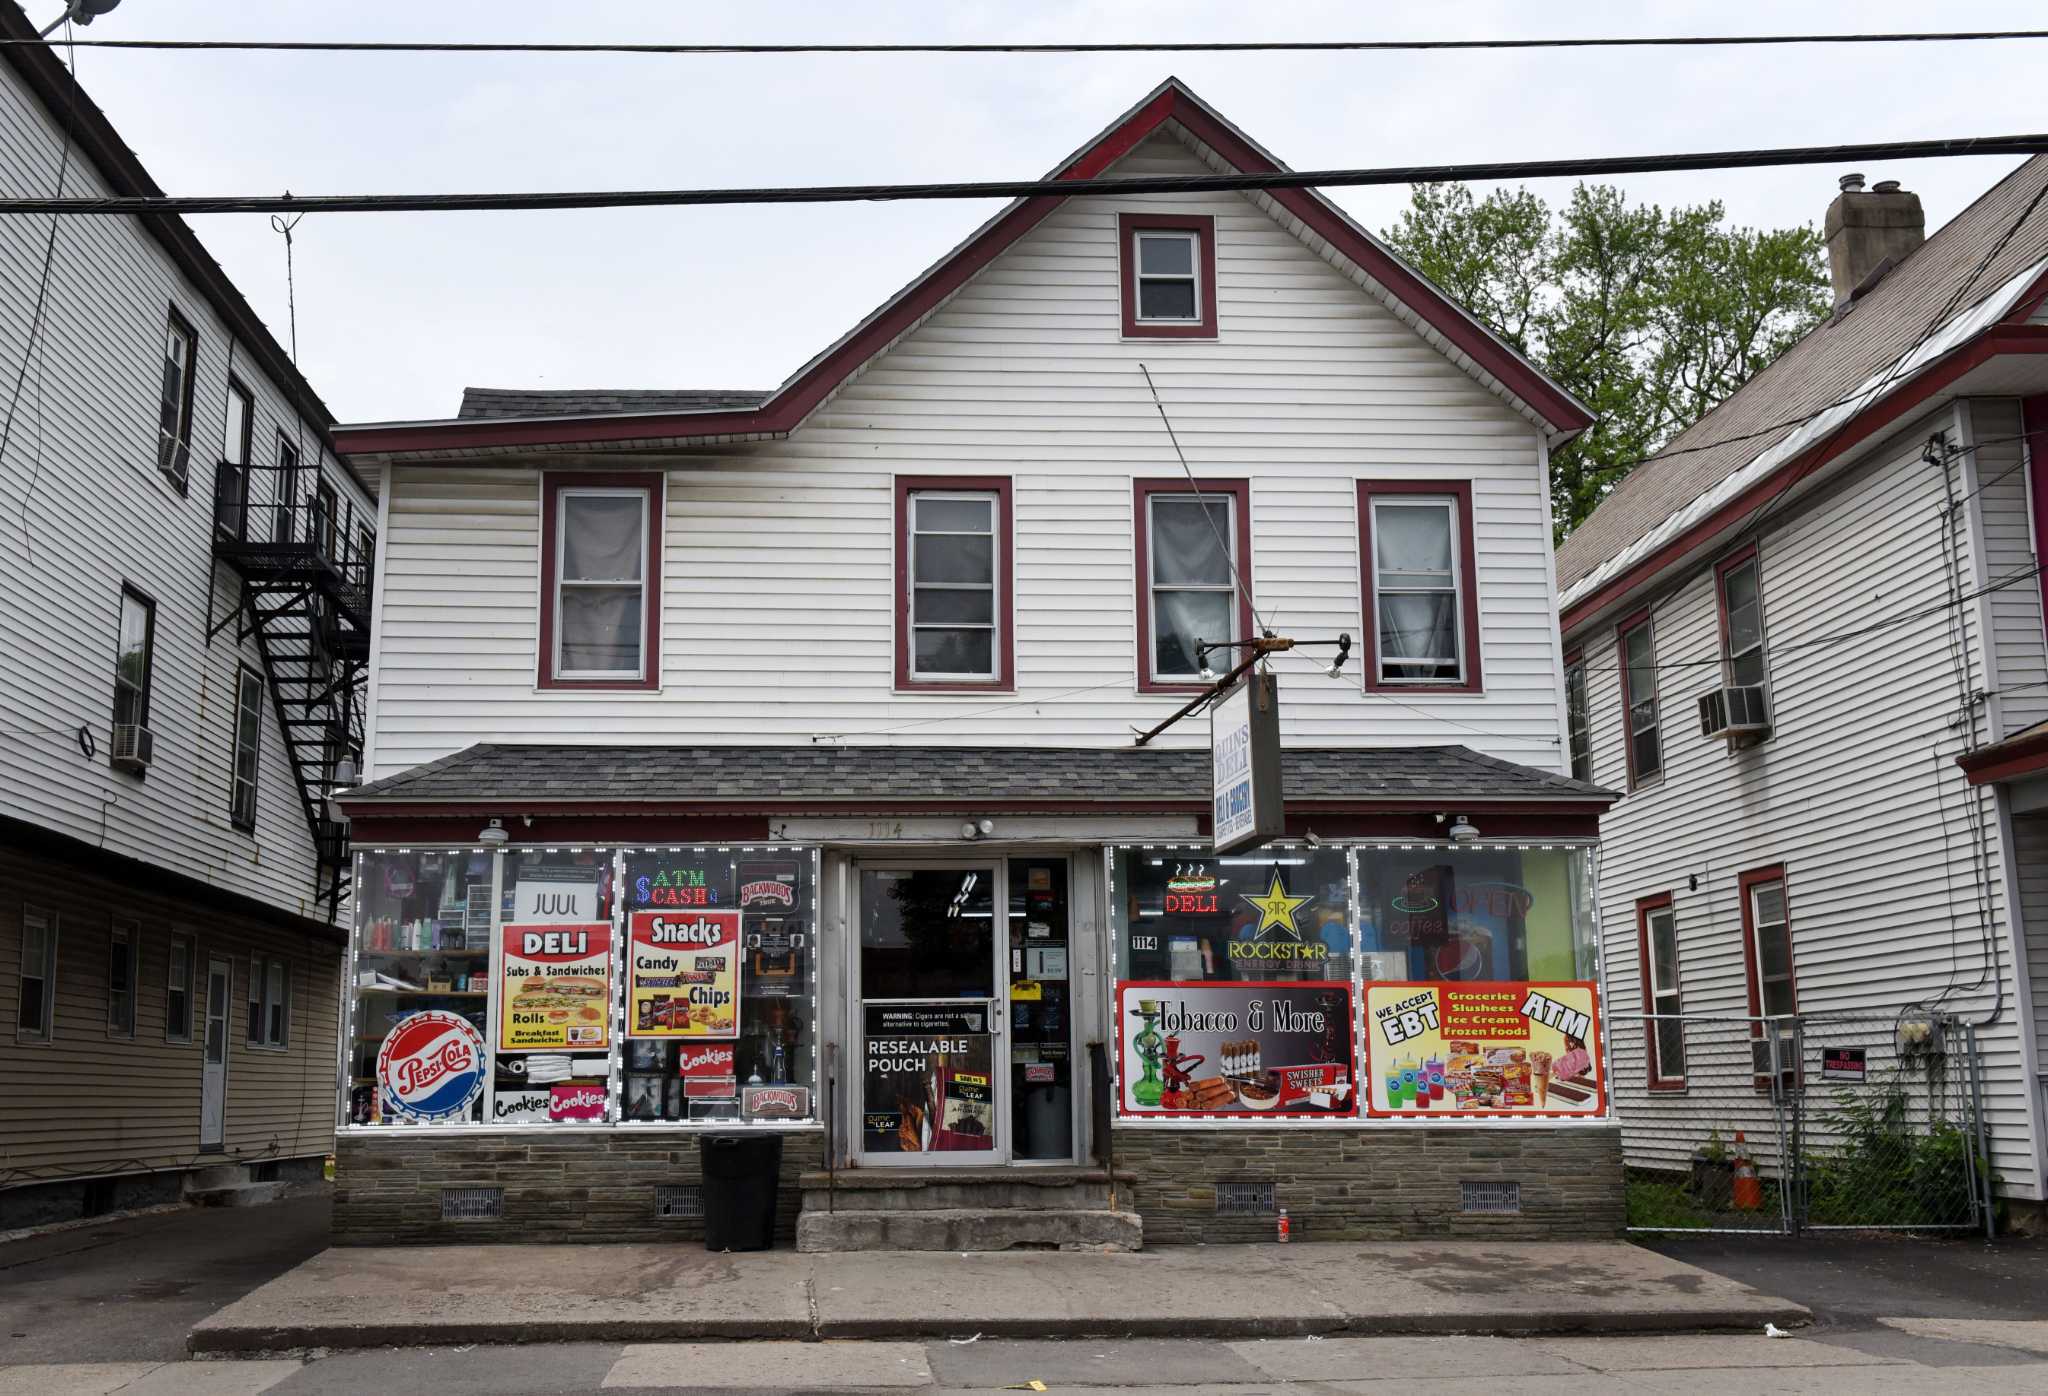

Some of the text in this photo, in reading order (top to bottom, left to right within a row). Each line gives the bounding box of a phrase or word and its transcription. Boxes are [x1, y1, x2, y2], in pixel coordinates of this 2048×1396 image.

[652, 870, 706, 886] ATM
[652, 887, 708, 904] CASH
[740, 881, 794, 906] BACKWOODS
[533, 893, 578, 915] JUUL
[1166, 895, 1217, 912] DELI
[652, 916, 722, 947] Snacks
[523, 930, 588, 955] DELI
[1133, 936, 1157, 950] 1114
[507, 964, 605, 977] Subs & Sandwiches
[637, 956, 678, 971] Candy
[689, 987, 730, 1008] Chips
[1376, 991, 1434, 1019] WE ACCEPT
[1448, 992, 1517, 1001] Groceries
[1156, 1000, 1325, 1032] Tobacco & More
[1452, 1003, 1514, 1012] Slushees
[1520, 991, 1590, 1041] ATM
[512, 1013, 544, 1024] Rolls
[882, 1012, 914, 1020] WARNING:
[915, 1013, 933, 1021] Cigars
[1381, 1002, 1440, 1046] EBT
[1447, 1015, 1520, 1024] Ice Cream
[1444, 1027, 1528, 1036] Frozen Foods
[868, 1040, 968, 1054] RESEALABLE
[679, 1048, 733, 1070] Cookies
[868, 1058, 926, 1072] POUCH
[1286, 1069, 1324, 1081] SWISHER
[1290, 1078, 1323, 1089] SWEETS
[496, 1095, 549, 1117] Cookies
[550, 1090, 604, 1112] Cookies
[751, 1090, 798, 1112] BACKWOODS
